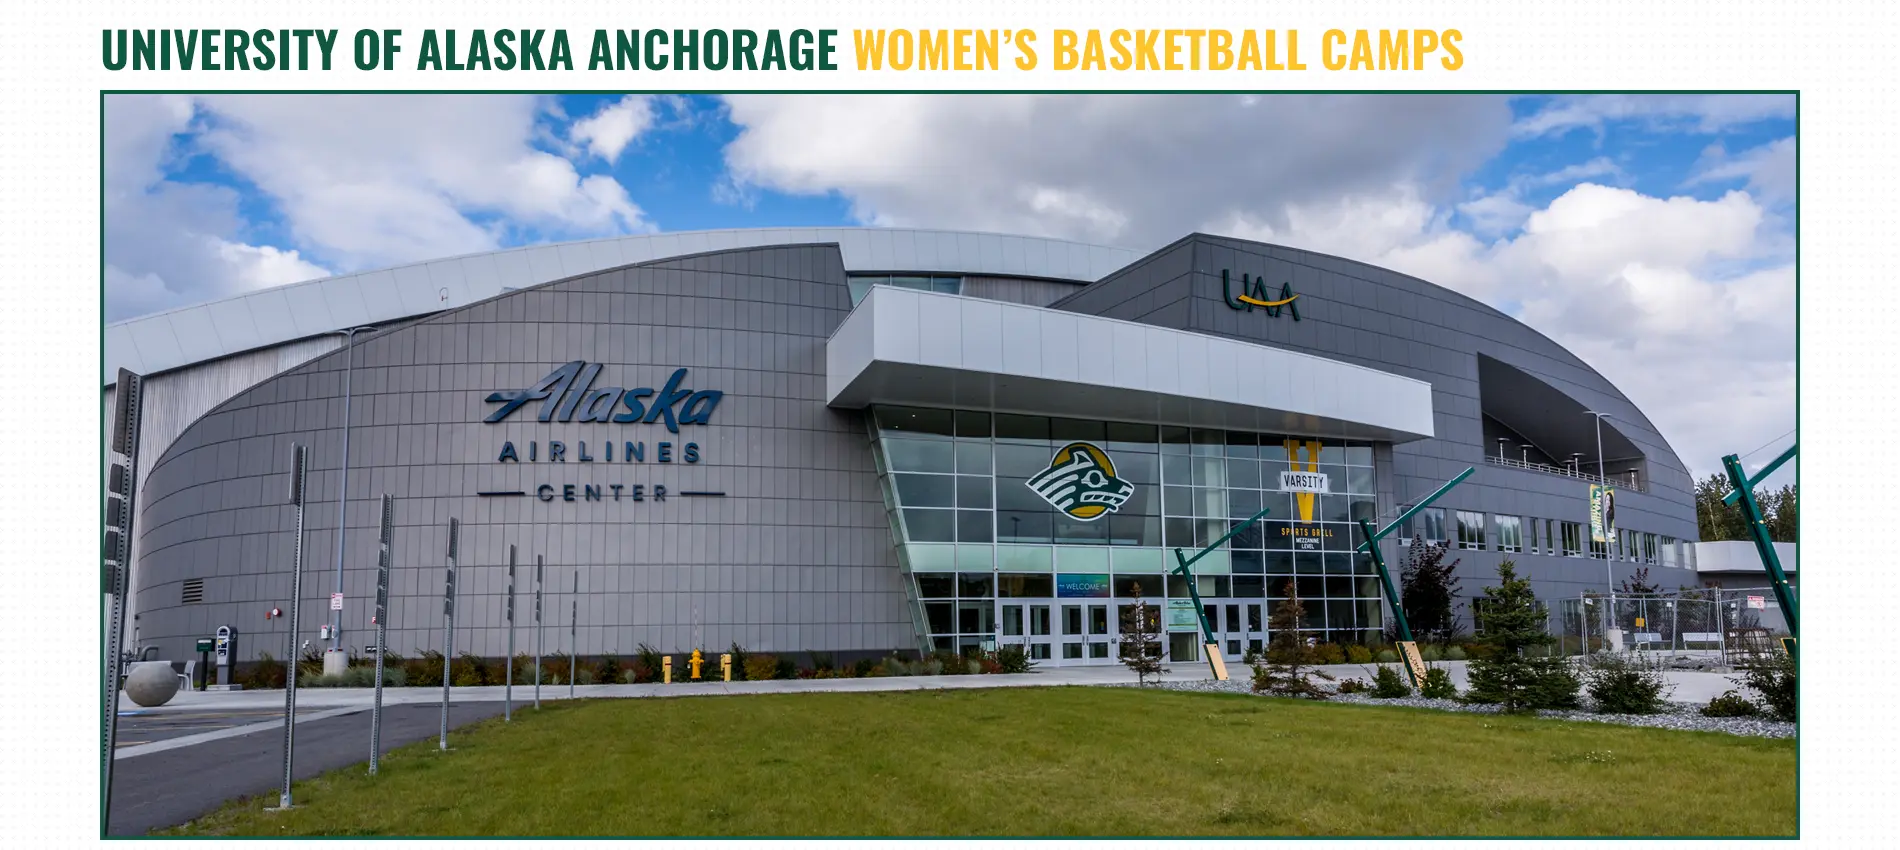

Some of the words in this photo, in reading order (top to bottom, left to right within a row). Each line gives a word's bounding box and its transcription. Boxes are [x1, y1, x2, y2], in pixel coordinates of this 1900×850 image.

[1222, 269, 1301, 321] UAA
[483, 360, 724, 434] Alaska
[498, 441, 701, 463] AIRLINES
[1283, 474, 1324, 489] VARSITY
[537, 485, 668, 503] CENTER
[1066, 582, 1100, 591] WELCOME
